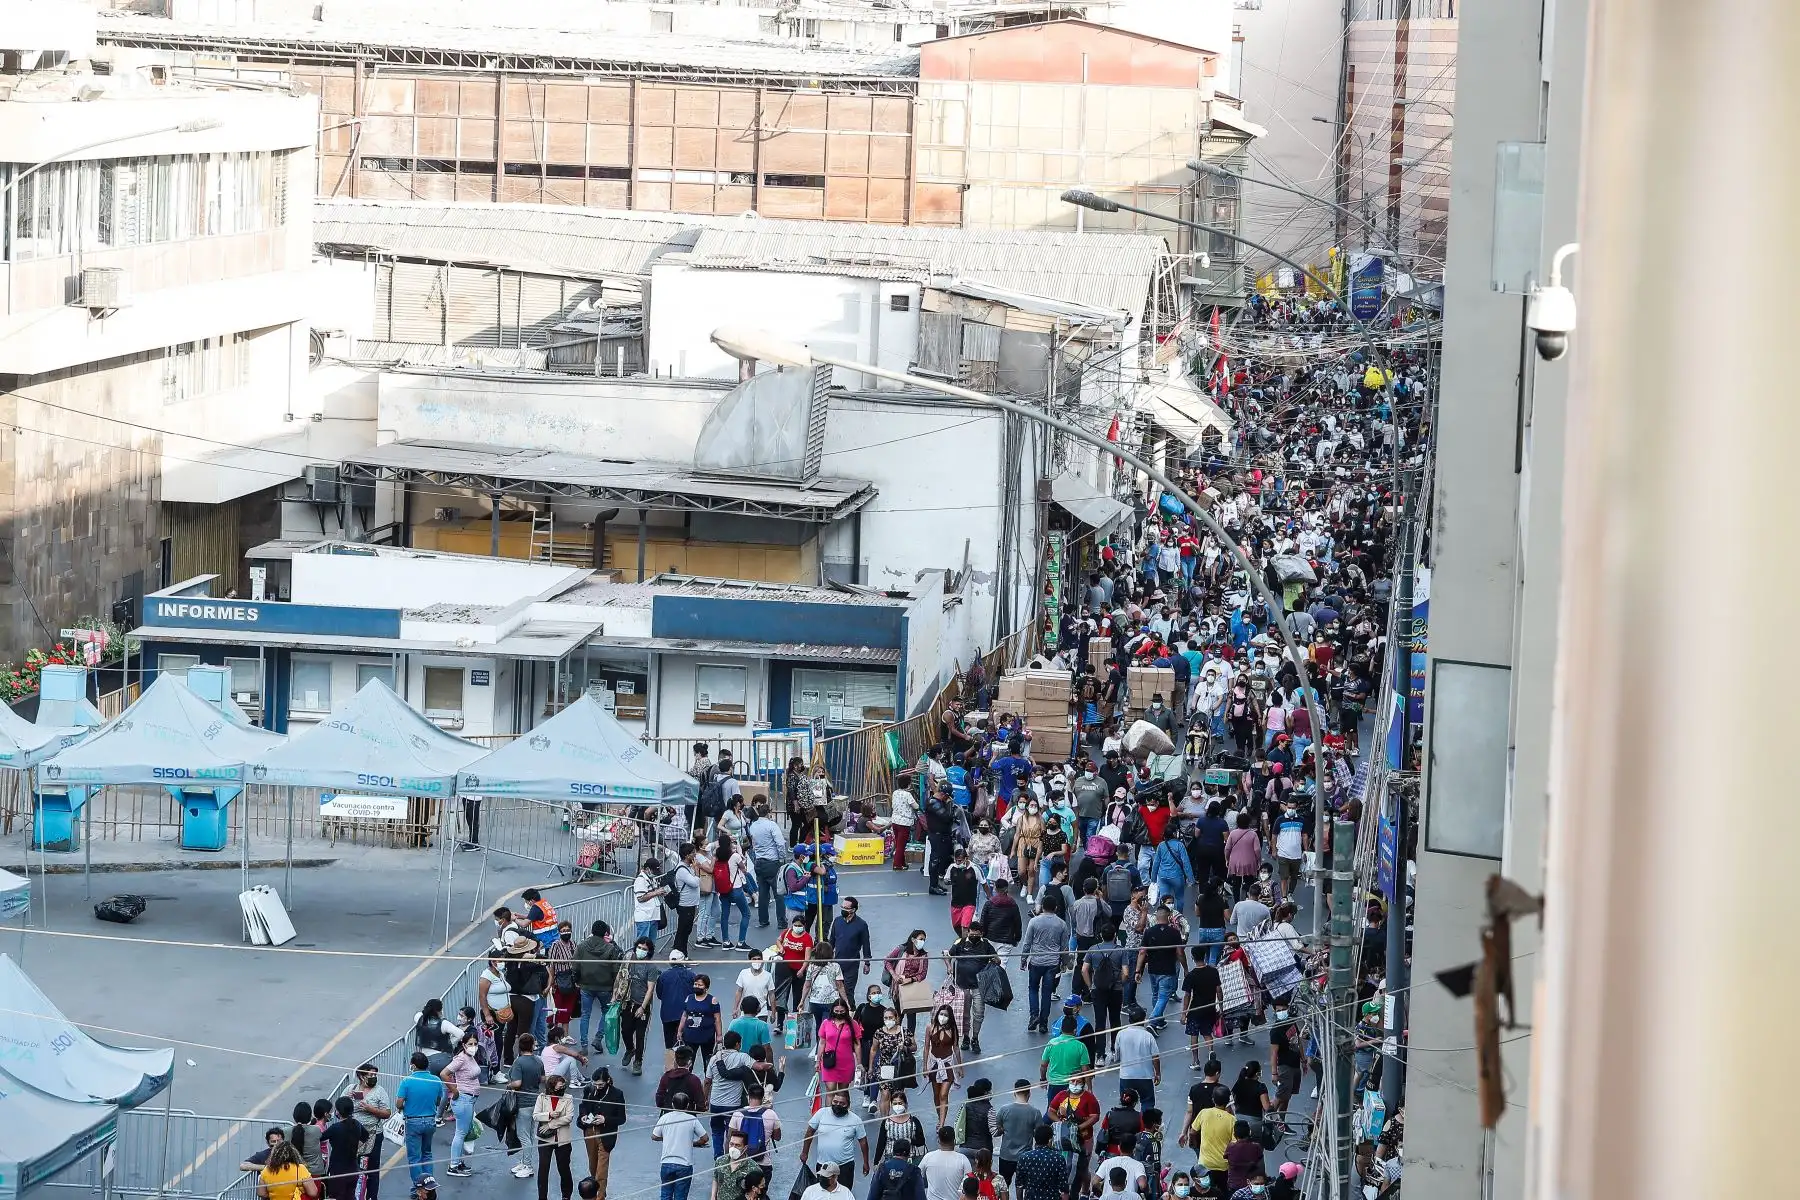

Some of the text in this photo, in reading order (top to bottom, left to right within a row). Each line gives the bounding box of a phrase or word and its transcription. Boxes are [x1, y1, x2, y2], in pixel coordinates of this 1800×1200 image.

[158, 602, 259, 621] INFORMES
[152, 767, 239, 779] SISOL SALUD
[357, 773, 443, 792] SISOL SALUD
[570, 783, 610, 796] SISOL
[347, 808, 381, 816] COVID-19
